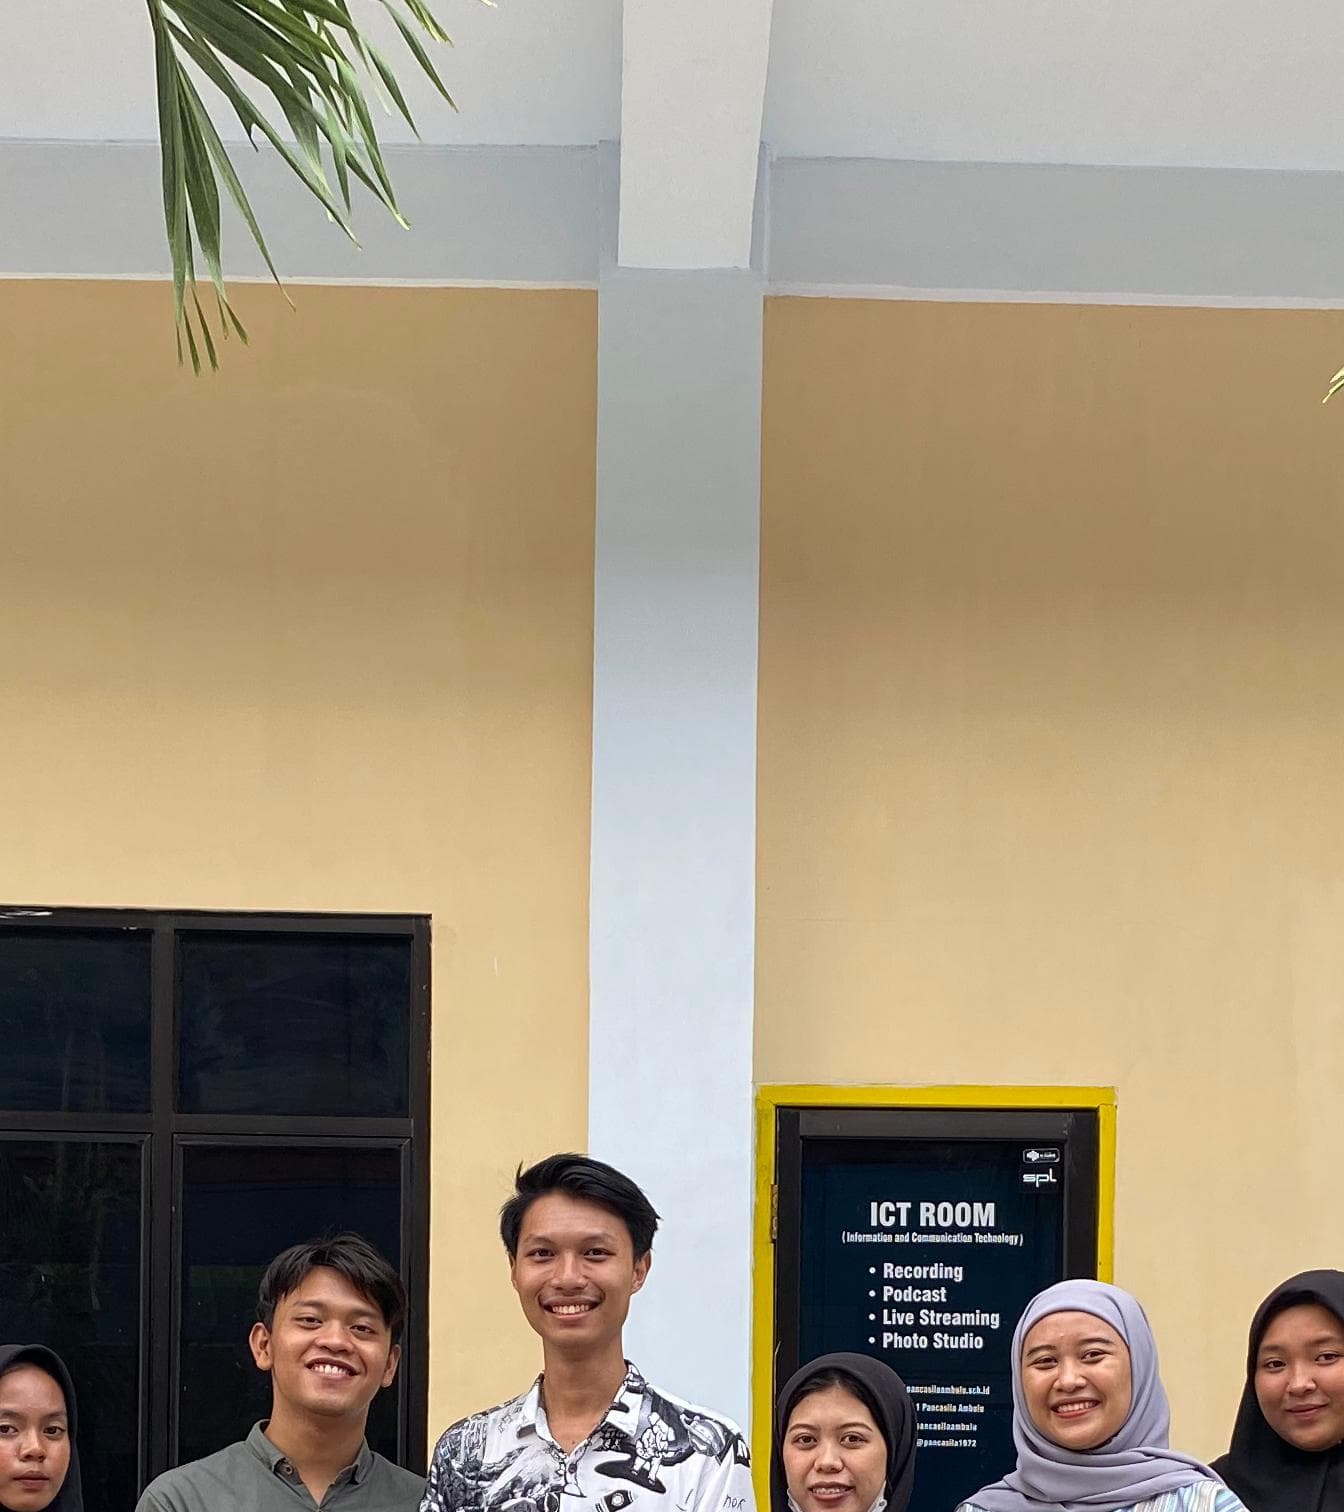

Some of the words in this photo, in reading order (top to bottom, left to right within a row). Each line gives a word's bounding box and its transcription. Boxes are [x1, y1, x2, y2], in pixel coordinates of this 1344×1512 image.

[870, 1201, 912, 1227] ICT
[919, 1201, 996, 1228] ROOM
[894, 1231, 910, 1244] and
[911, 1231, 973, 1244] Communication
[883, 1262, 964, 1283] Recording
[883, 1285, 948, 1302] Podcast
[882, 1308, 915, 1326] Live
[919, 1309, 1000, 1330] Streaming
[882, 1332, 929, 1349] Photo
[932, 1332, 984, 1350] Studio
